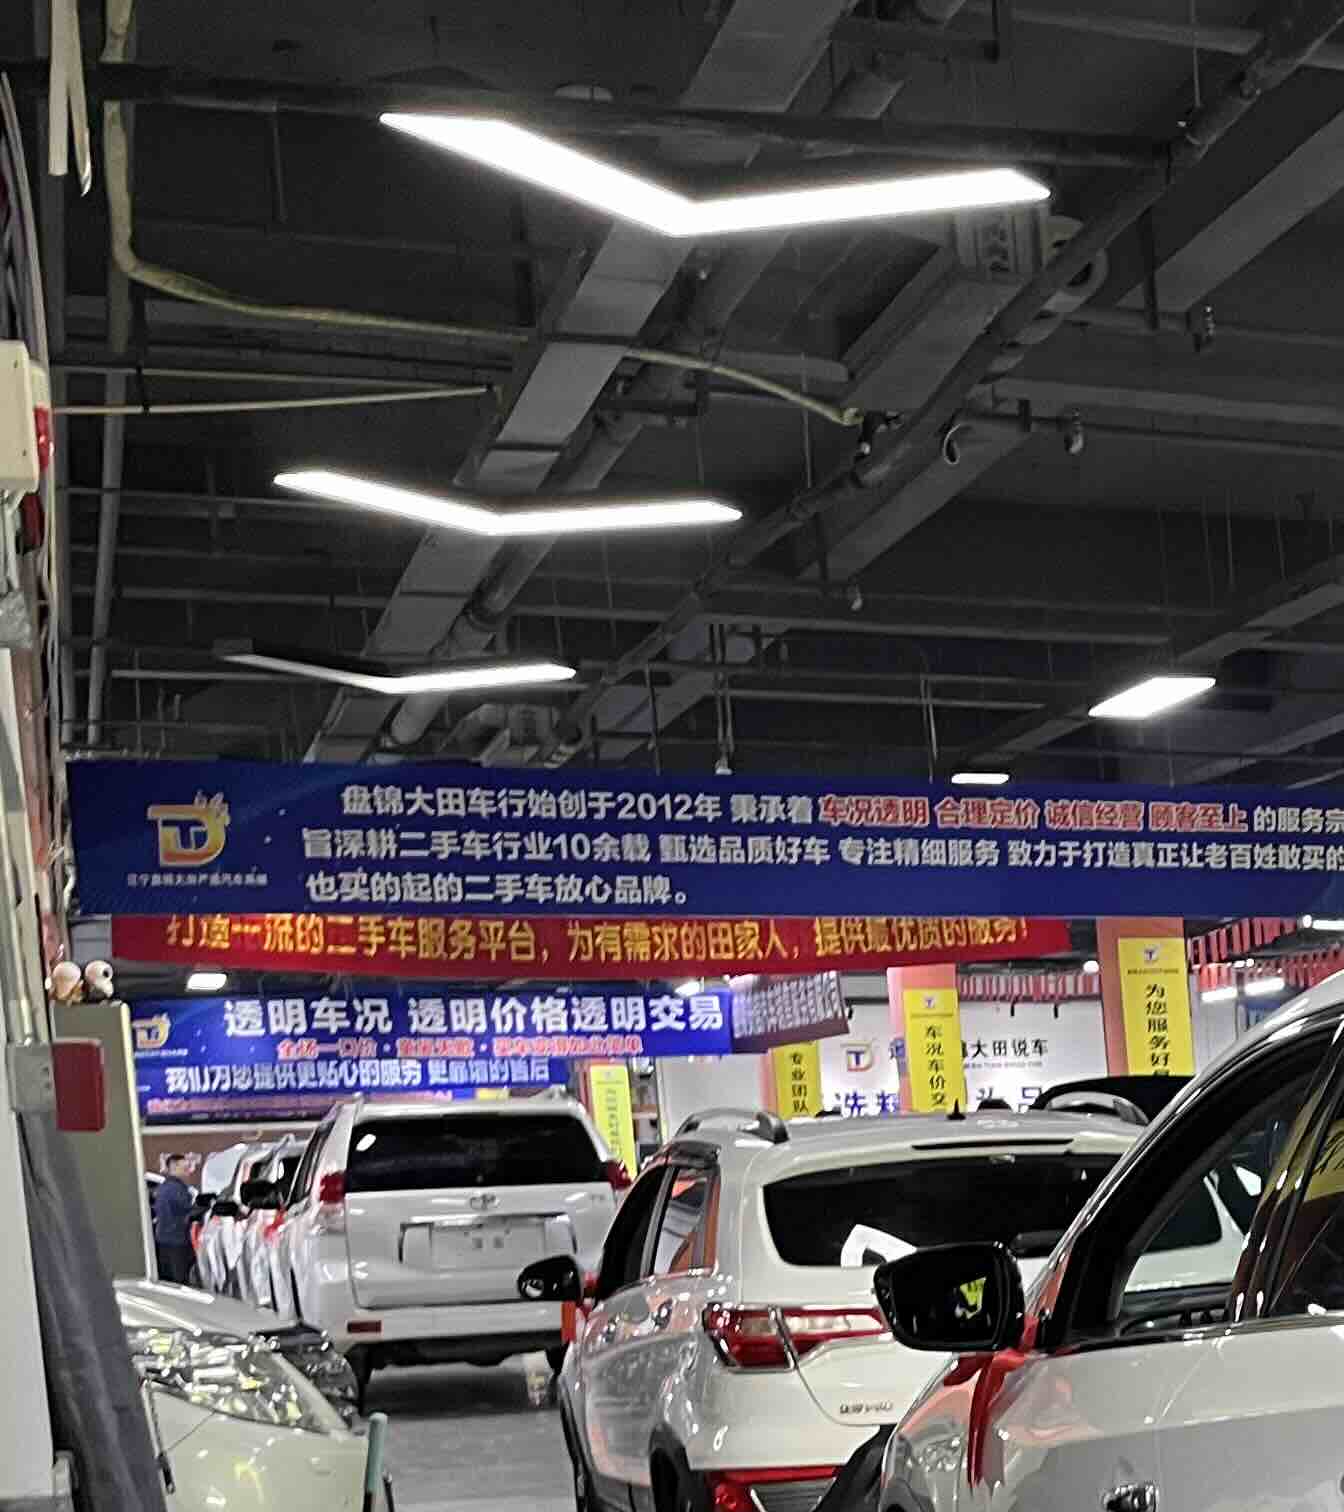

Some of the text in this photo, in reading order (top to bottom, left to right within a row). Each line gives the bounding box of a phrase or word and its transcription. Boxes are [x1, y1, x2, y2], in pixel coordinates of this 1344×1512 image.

[340, 785, 722, 823] 盘锦大田车行始创于2012年
[818, 793, 930, 828] 车况透明
[935, 798, 1040, 831] 合理定价
[1044, 799, 1145, 833] 诚信经营
[302, 825, 652, 863] 旨深耕二手车行业10余载
[658, 833, 831, 866] 甄选品质好车
[838, 836, 1000, 867] 专注精细服务
[223, 997, 393, 1037] 透明车况
[407, 994, 723, 1036] 透明价格透明交易
[1144, 983, 1170, 1076] 为您服务好
[959, 1039, 1048, 1059] 大田说车
